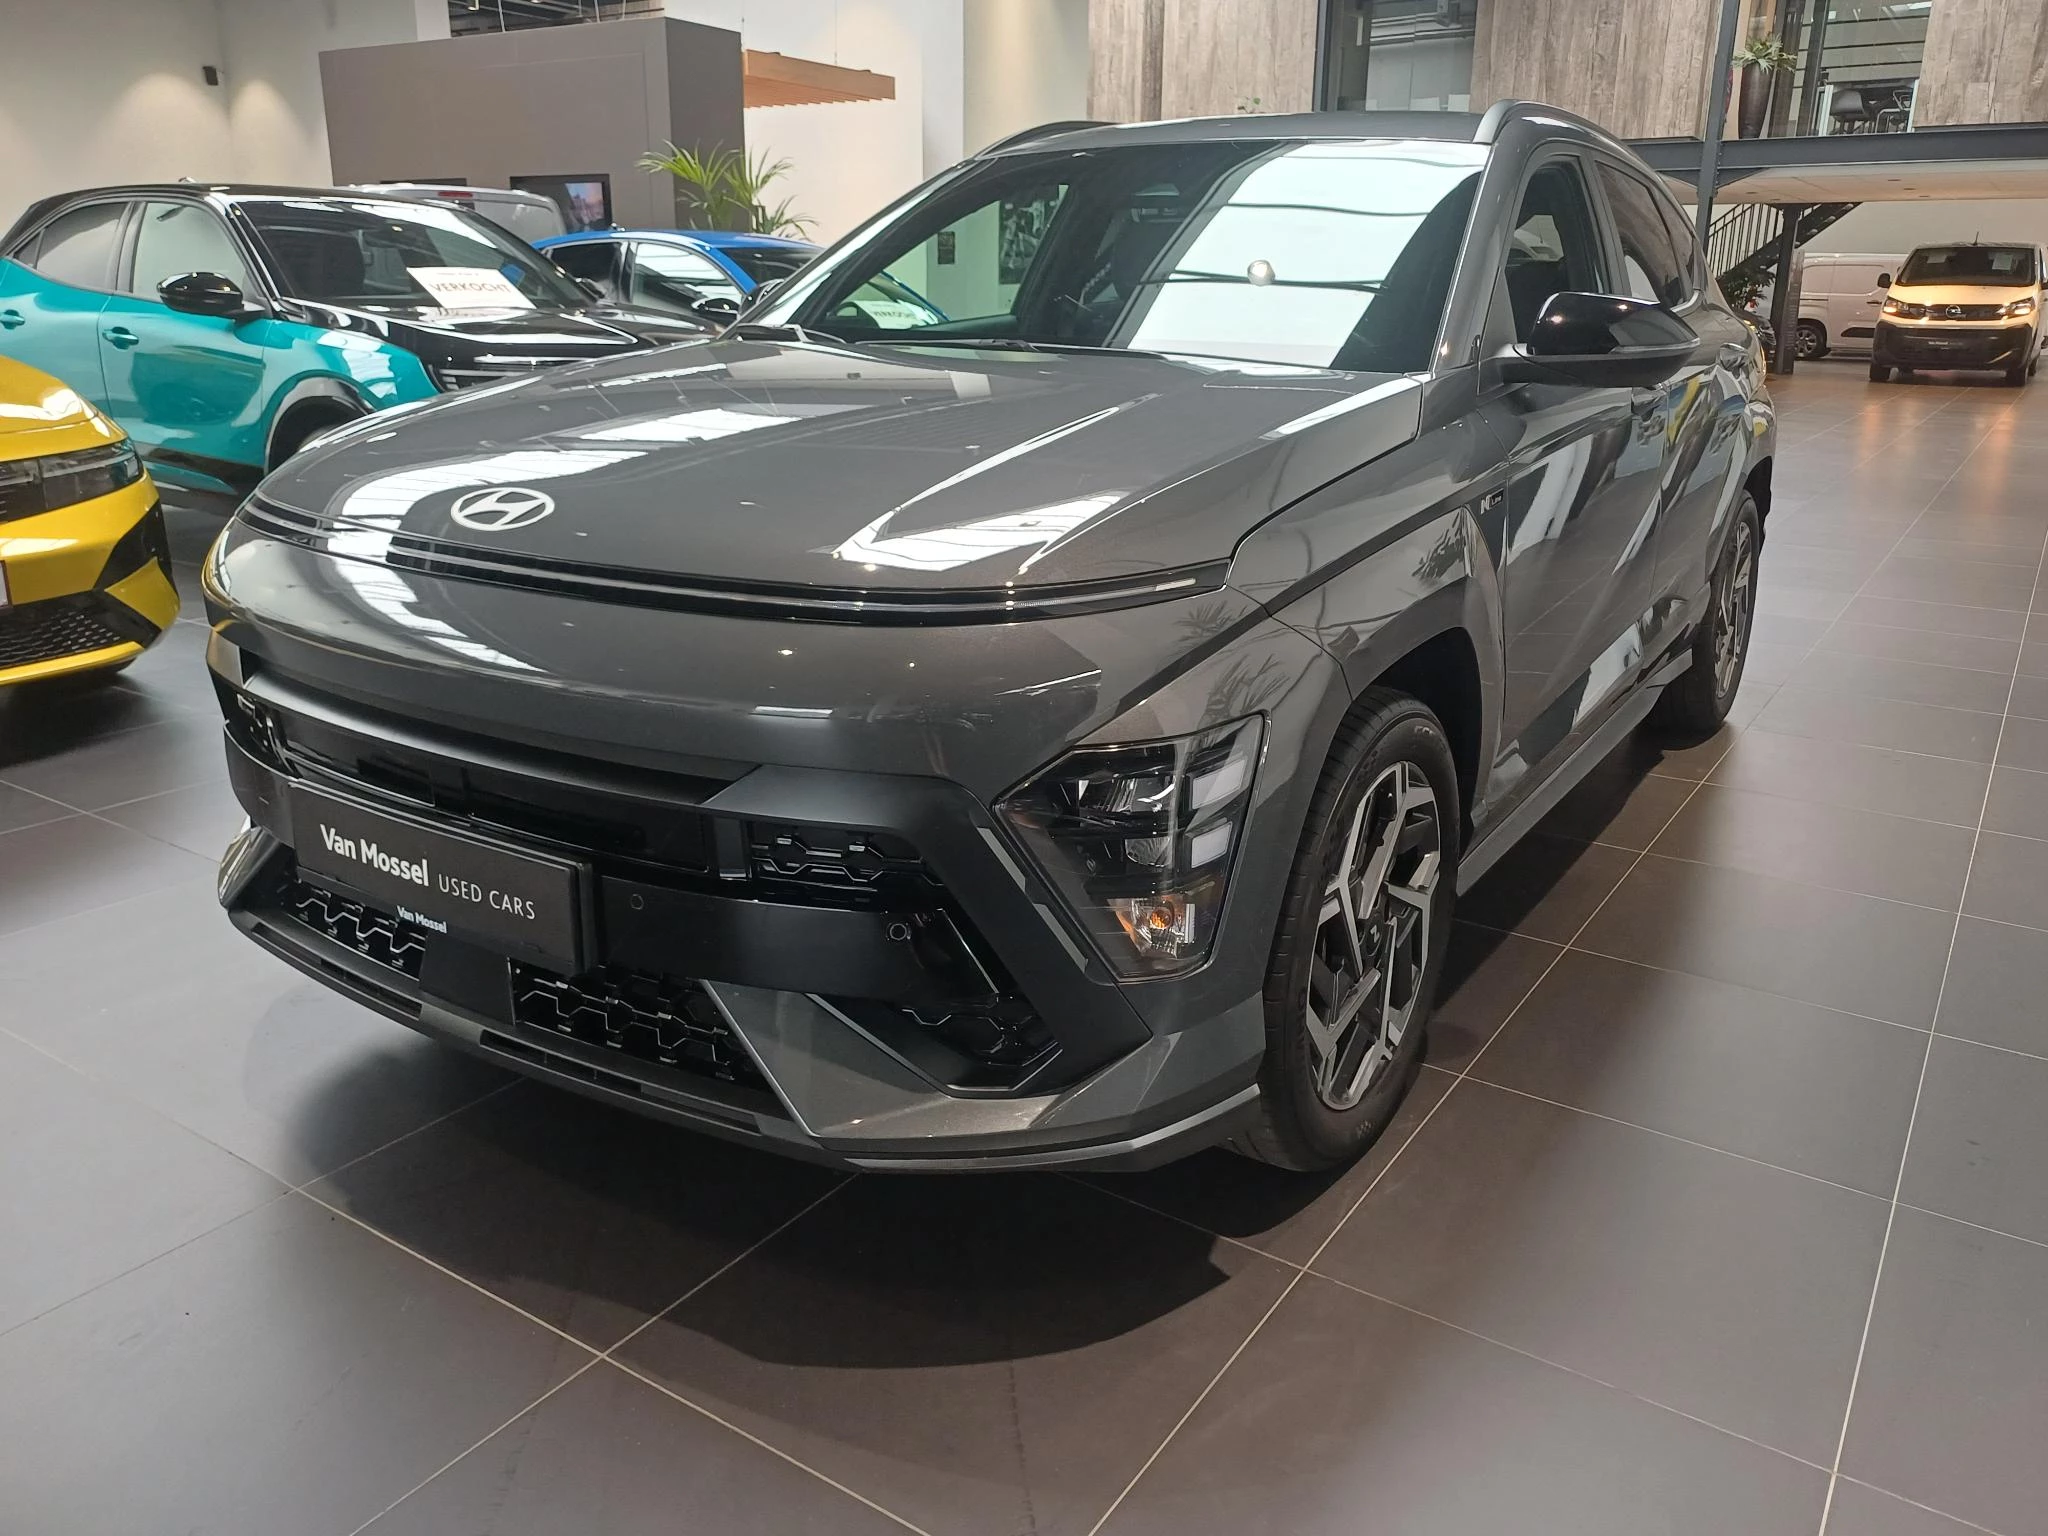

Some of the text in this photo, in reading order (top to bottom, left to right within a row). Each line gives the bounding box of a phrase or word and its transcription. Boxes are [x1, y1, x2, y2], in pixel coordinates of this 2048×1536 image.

[429, 282, 512, 294] VERKOCHT
[320, 823, 536, 920] Van Mossel USED CARS
[397, 905, 447, 934] Van Mossel
